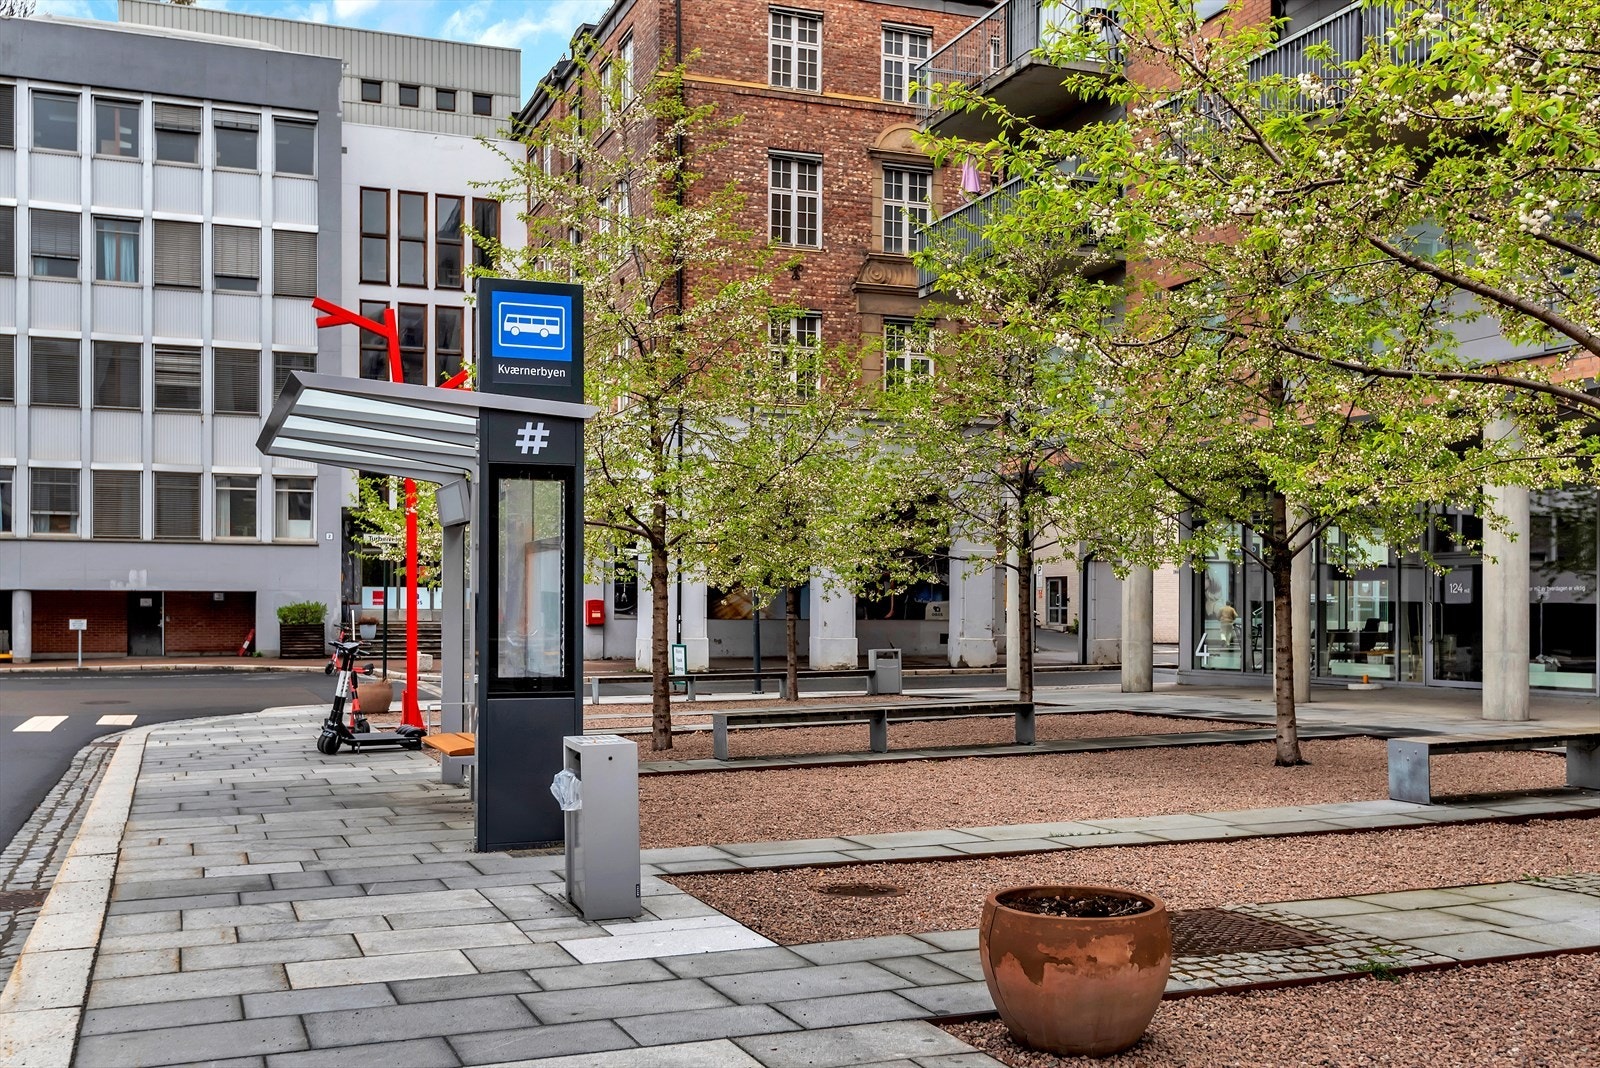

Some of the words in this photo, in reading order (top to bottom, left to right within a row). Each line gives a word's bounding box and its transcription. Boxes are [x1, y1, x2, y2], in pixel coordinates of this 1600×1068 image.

[498, 363, 566, 379] Kværnerbyen
[1449, 582, 1463, 594] 124
[1195, 632, 1210, 665] 4
